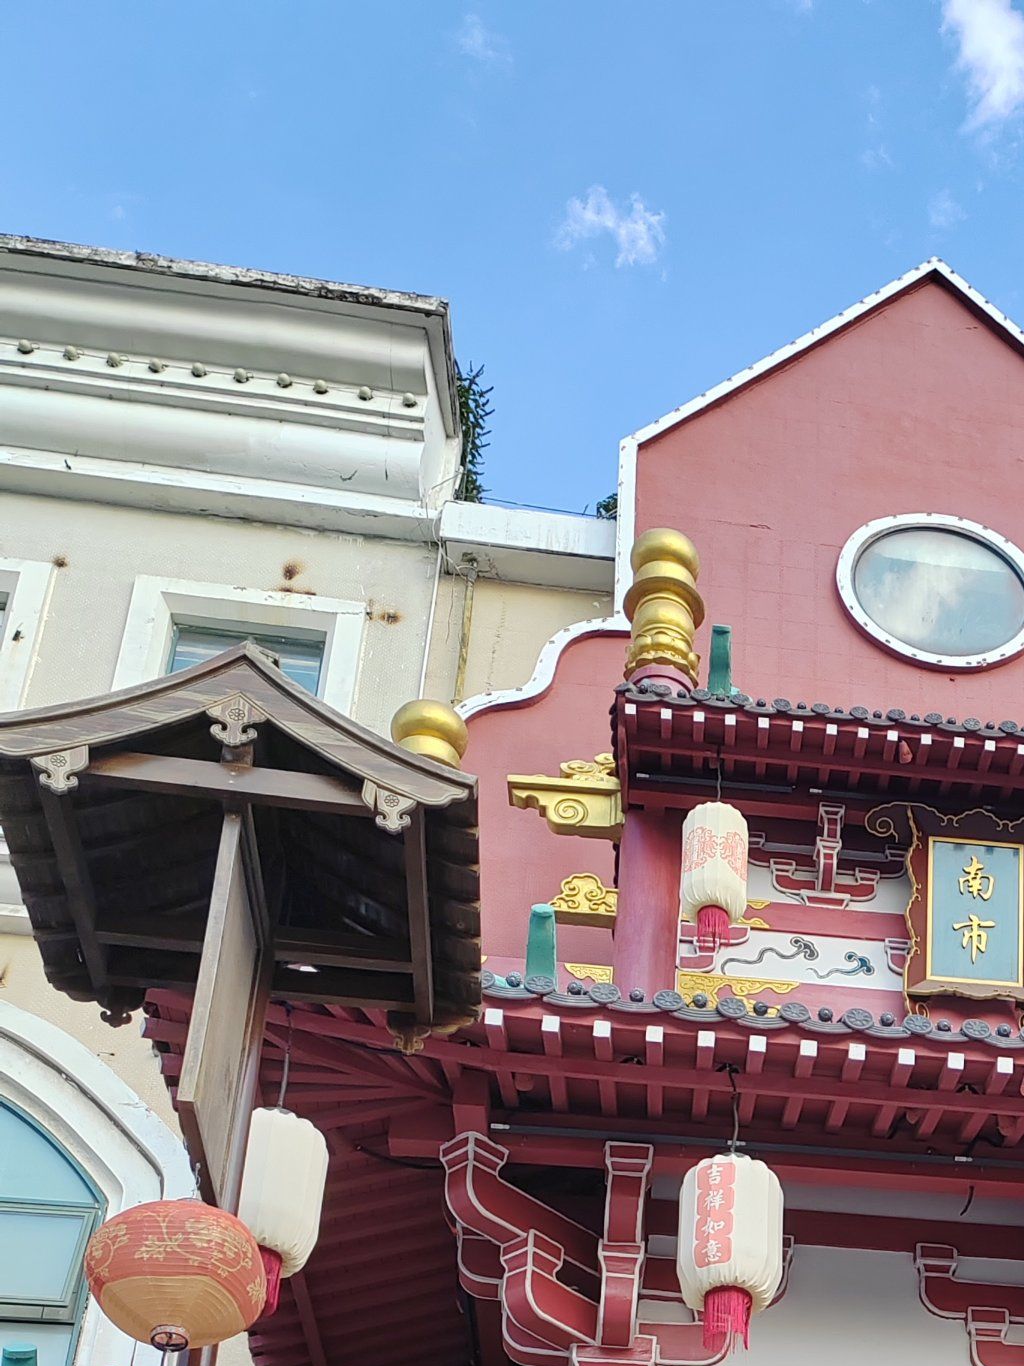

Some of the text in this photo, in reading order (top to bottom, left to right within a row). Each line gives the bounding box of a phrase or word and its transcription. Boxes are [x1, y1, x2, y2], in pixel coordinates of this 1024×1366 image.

[953, 855, 996, 965] 南市
[701, 1164, 726, 1263] 吉祥如意
